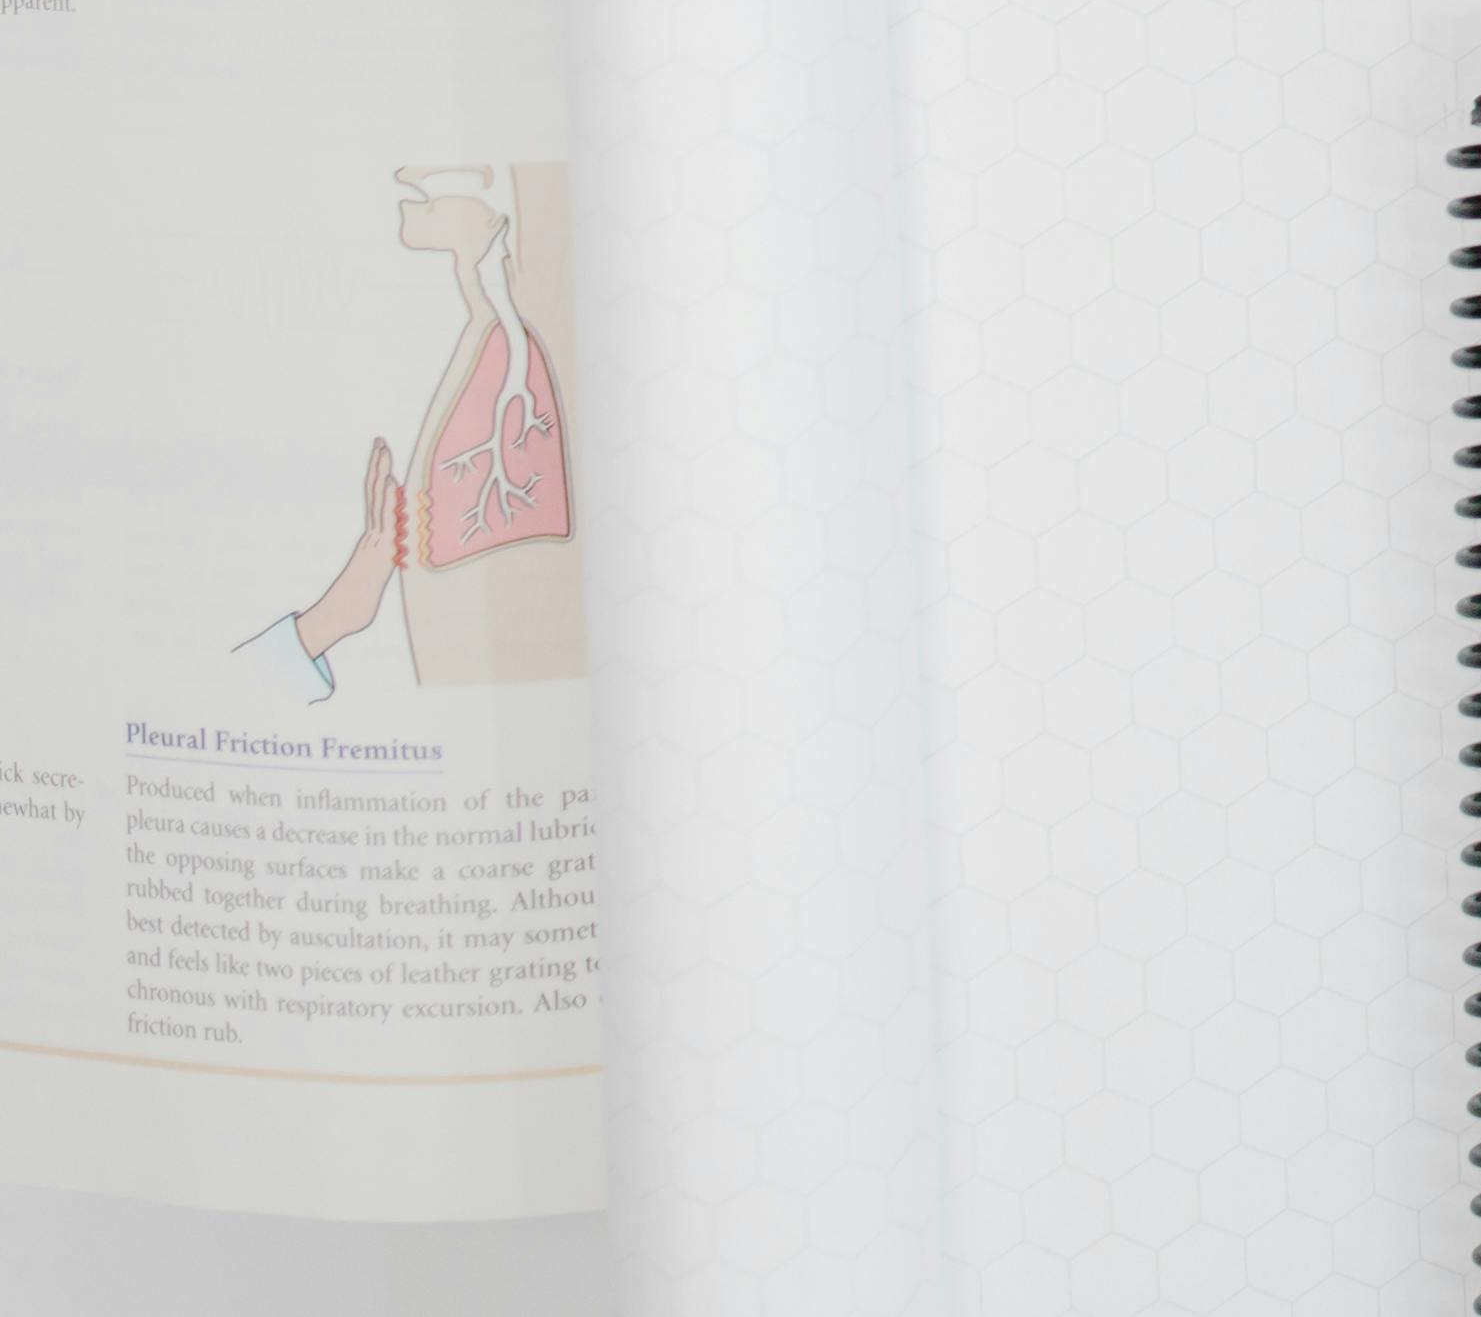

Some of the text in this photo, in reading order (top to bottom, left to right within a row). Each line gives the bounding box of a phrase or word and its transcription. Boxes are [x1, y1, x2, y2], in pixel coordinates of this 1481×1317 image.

[125, 721, 443, 761] Pleural Friction Fremitus
[127, 1010, 243, 1044] friction rub.
